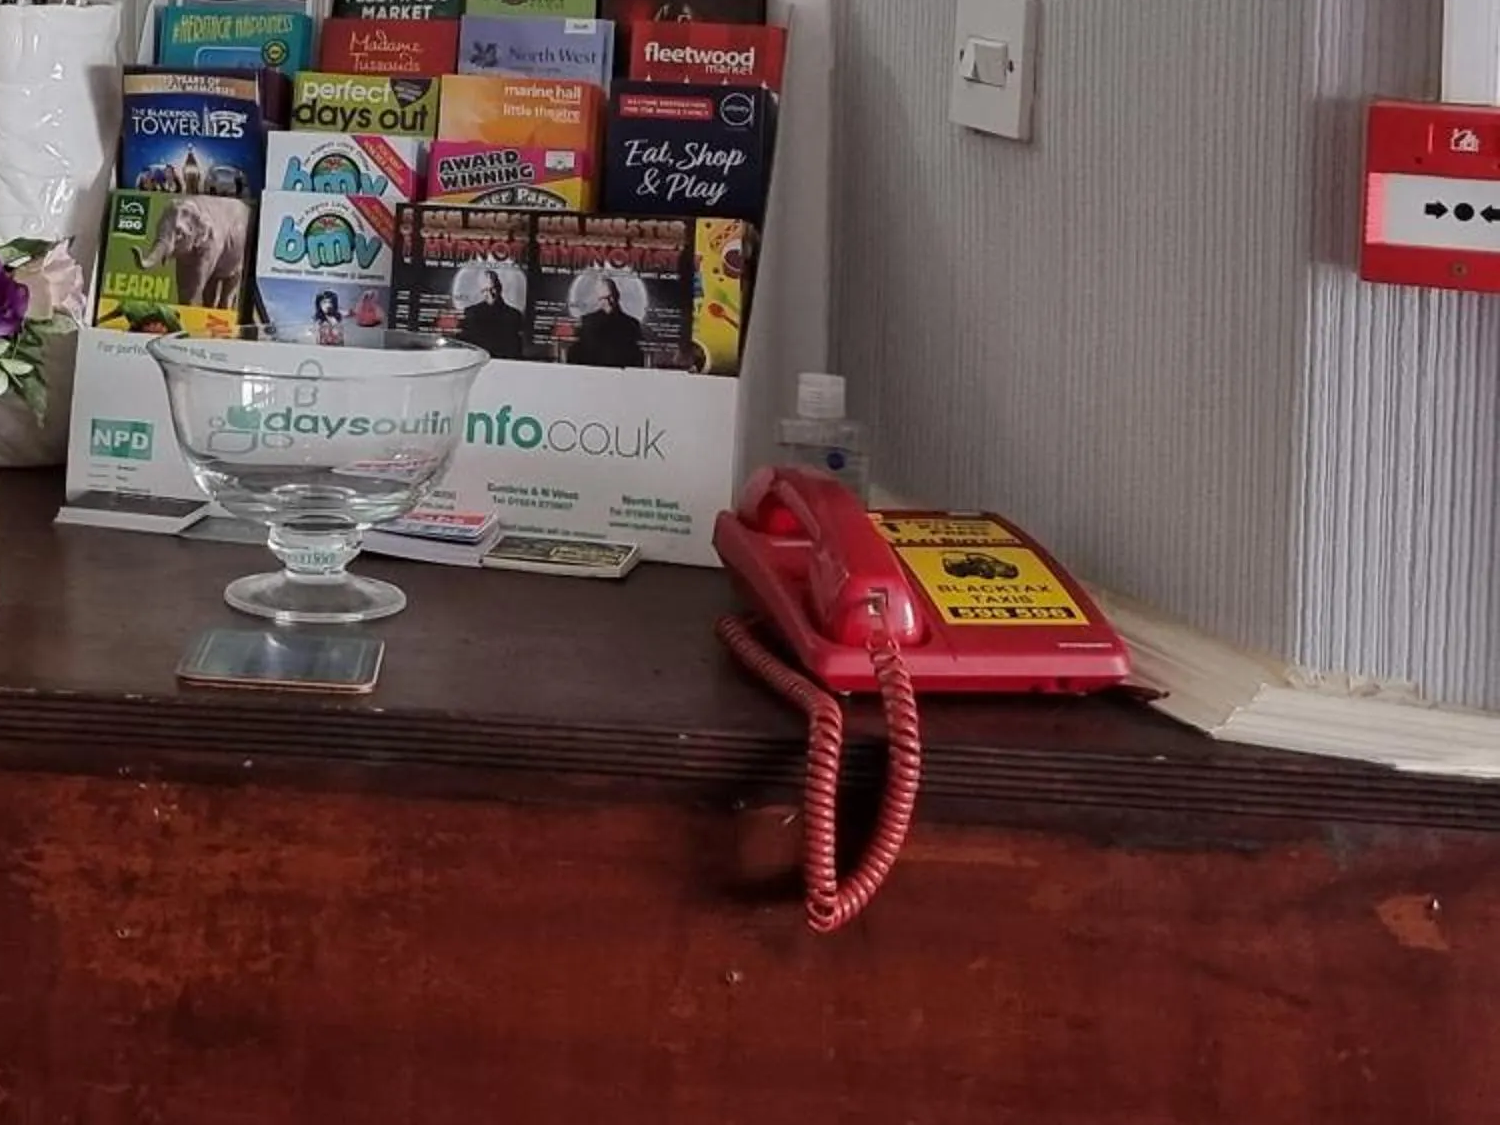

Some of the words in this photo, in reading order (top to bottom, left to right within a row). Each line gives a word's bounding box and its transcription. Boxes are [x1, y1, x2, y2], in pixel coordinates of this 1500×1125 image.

[361, 4, 434, 20] MARKET
[350, 29, 424, 53] Madame
[644, 41, 755, 65] fleetwood
[349, 52, 421, 73] Tussauds
[509, 45, 555, 64] North
[558, 47, 597, 65] West
[705, 64, 754, 76] market
[303, 78, 393, 104] perfect
[504, 83, 554, 98] marine
[555, 85, 582, 99] hall
[147, 108, 199, 119] BLACKPOOL
[292, 97, 372, 133] days
[378, 104, 429, 132] out
[503, 103, 532, 117] little
[534, 105, 581, 120] theatre
[131, 115, 202, 136] TOWER
[212, 120, 244, 139] 125
[438, 149, 519, 174] AWARD
[624, 138, 674, 167] Eat,
[675, 141, 747, 175] Shop
[438, 164, 534, 190] WINNING
[635, 167, 661, 196] &
[666, 172, 728, 206] Play
[117, 218, 143, 230] ZOO
[274, 214, 383, 270] bmv
[104, 272, 171, 300] LEARN
[92, 427, 150, 451] NPD
